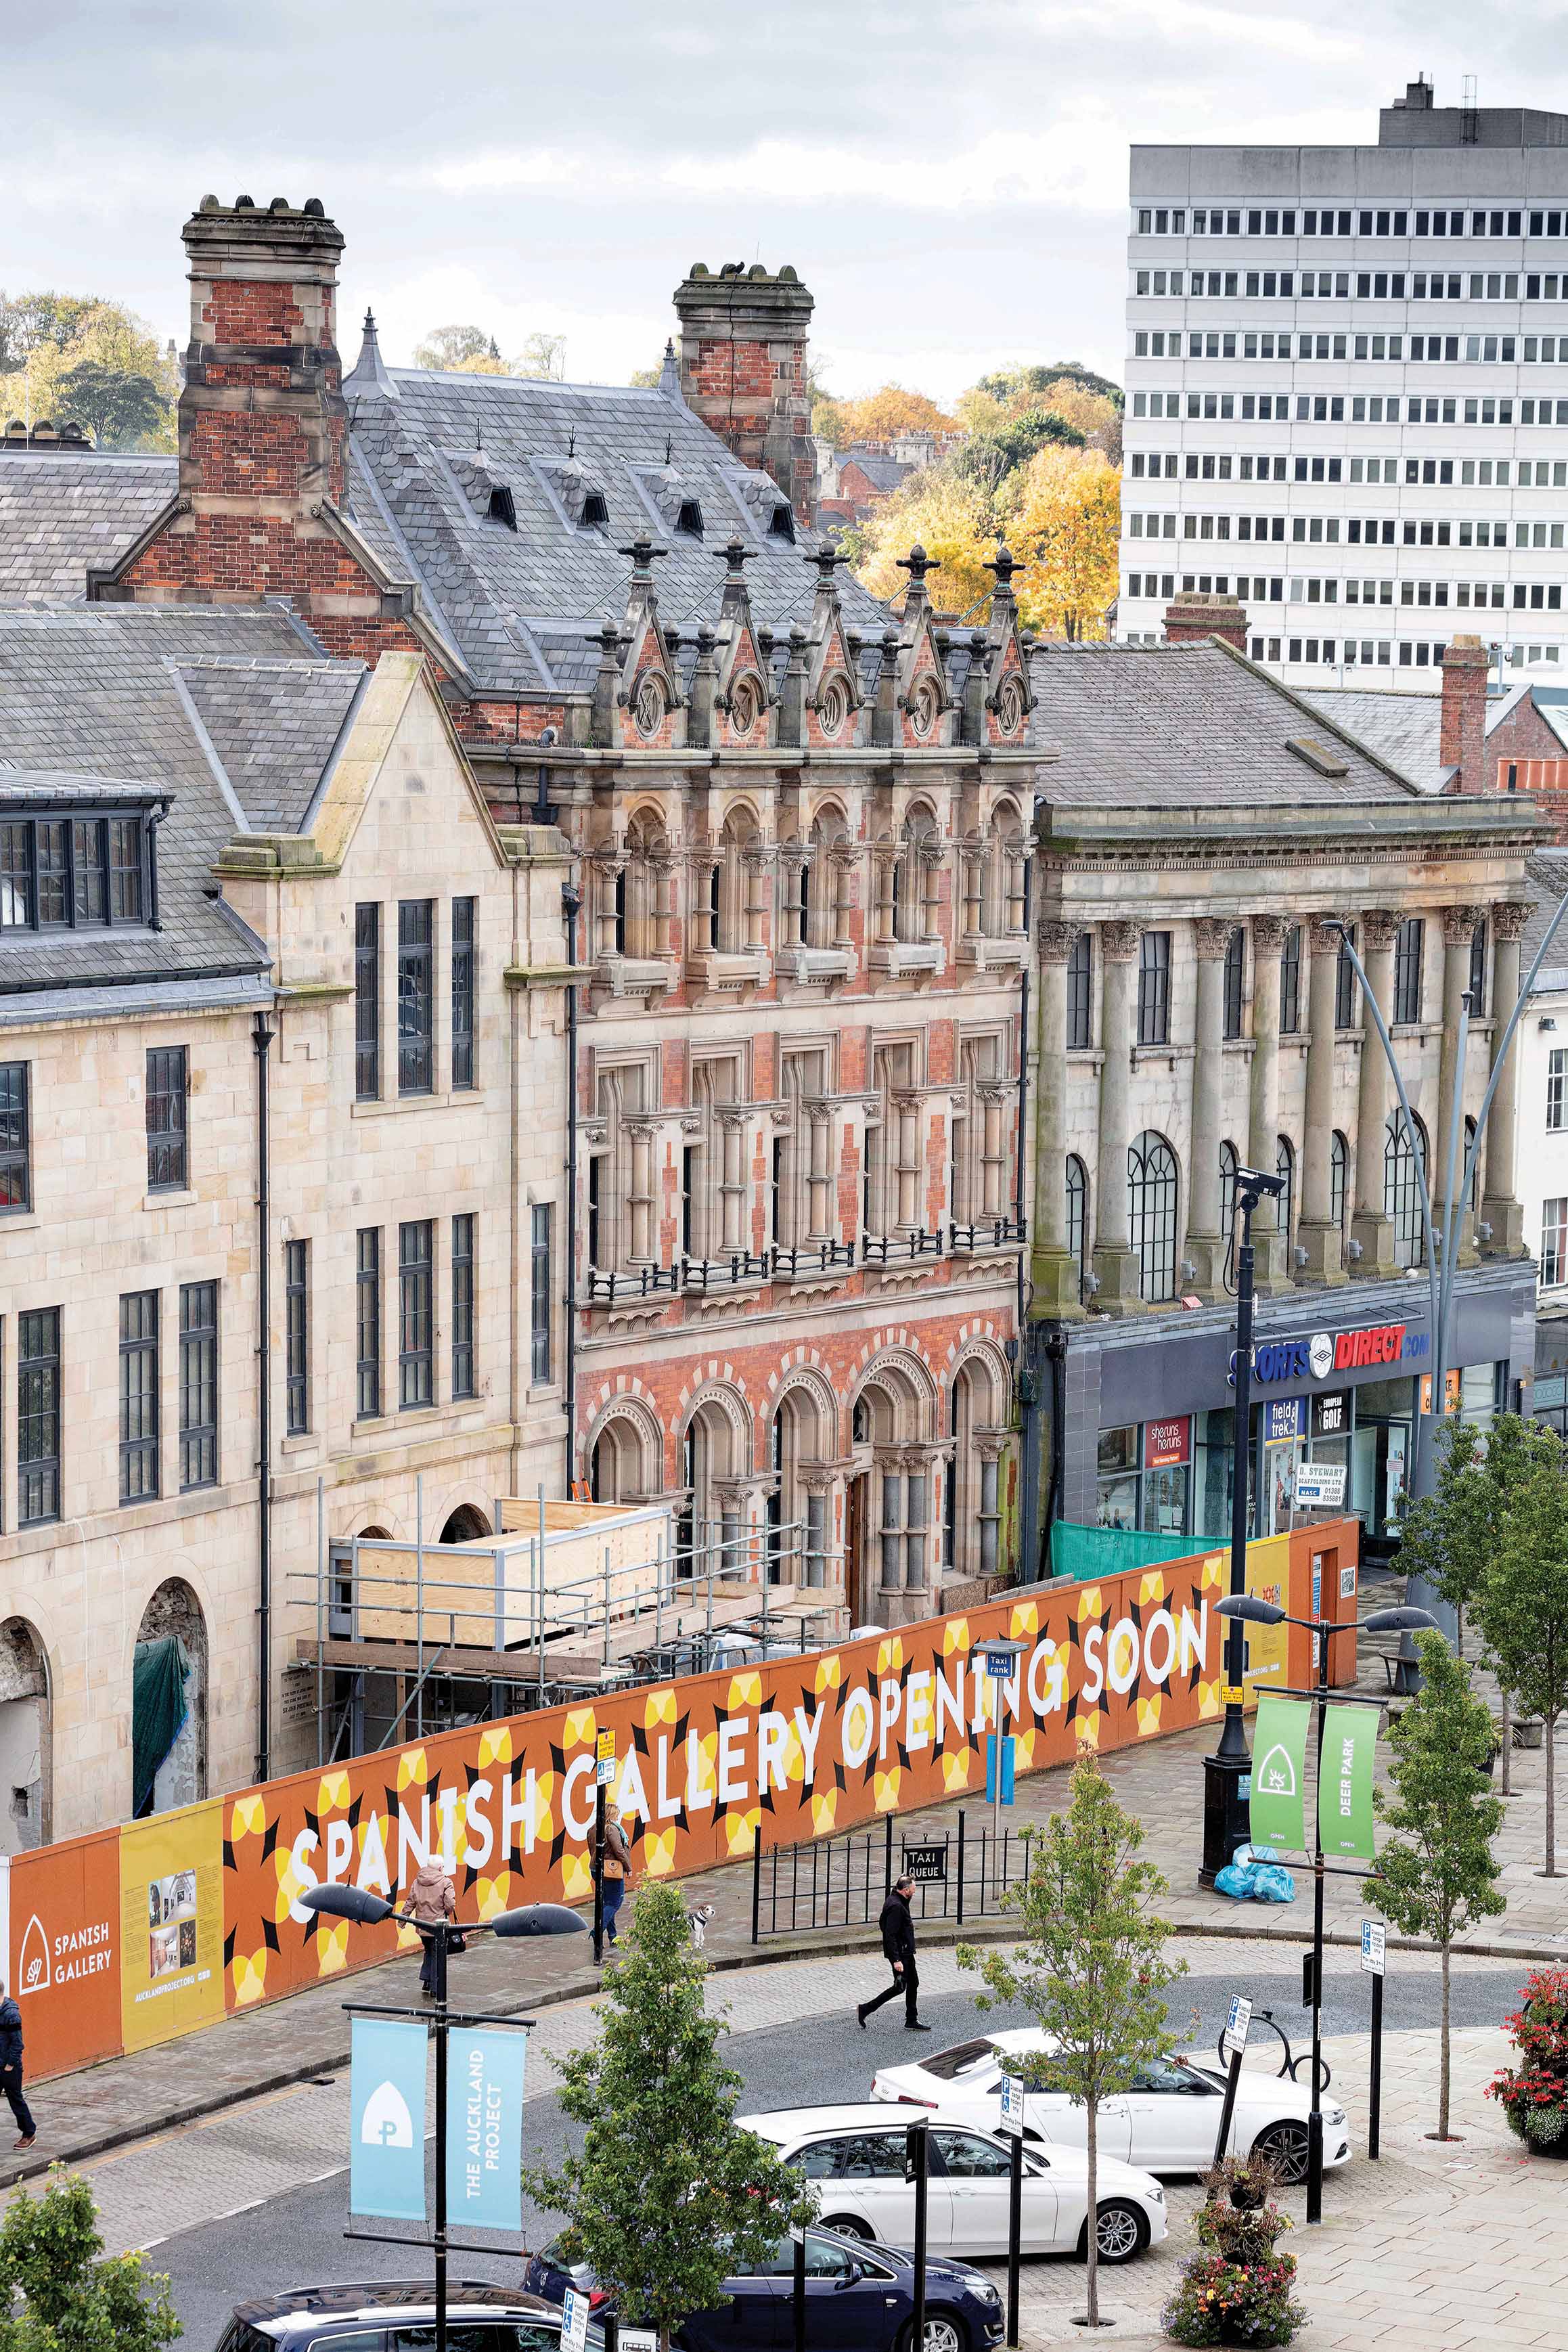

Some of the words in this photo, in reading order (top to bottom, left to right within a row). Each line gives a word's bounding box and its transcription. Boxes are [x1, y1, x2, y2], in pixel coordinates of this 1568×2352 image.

[1272, 1401, 1291, 1420] field
[1323, 1396, 1343, 1408] EUROPEAN
[1272, 1419, 1294, 1437] trek.co
[1323, 1408, 1342, 1430] GOLF
[1299, 1467, 1306, 1475] D.
[1309, 1467, 1344, 1477] STEWART
[990, 1656, 1007, 1665] Taxi
[990, 1666, 1008, 1674] rank
[290, 1767, 535, 1924] SPANISH
[561, 1700, 826, 1842] GALLERY
[841, 1639, 1063, 1769] OPENING
[1081, 1598, 1209, 1703] SOON
[1341, 1737, 1355, 1775] PARK
[1341, 1779, 1351, 1817] DEER
[909, 1852, 935, 1863] TAXI
[909, 1867, 939, 1878] QUEUE
[55, 1922, 108, 1956] SPANISH
[55, 1949, 112, 1984] GALLERY
[135, 1975, 196, 2003] AUCKLANDPROJECT.ORG
[466, 2050, 484, 2156] AUCKLAND
[485, 2083, 501, 2170] PROJECT
[466, 2162, 481, 2198] THE
